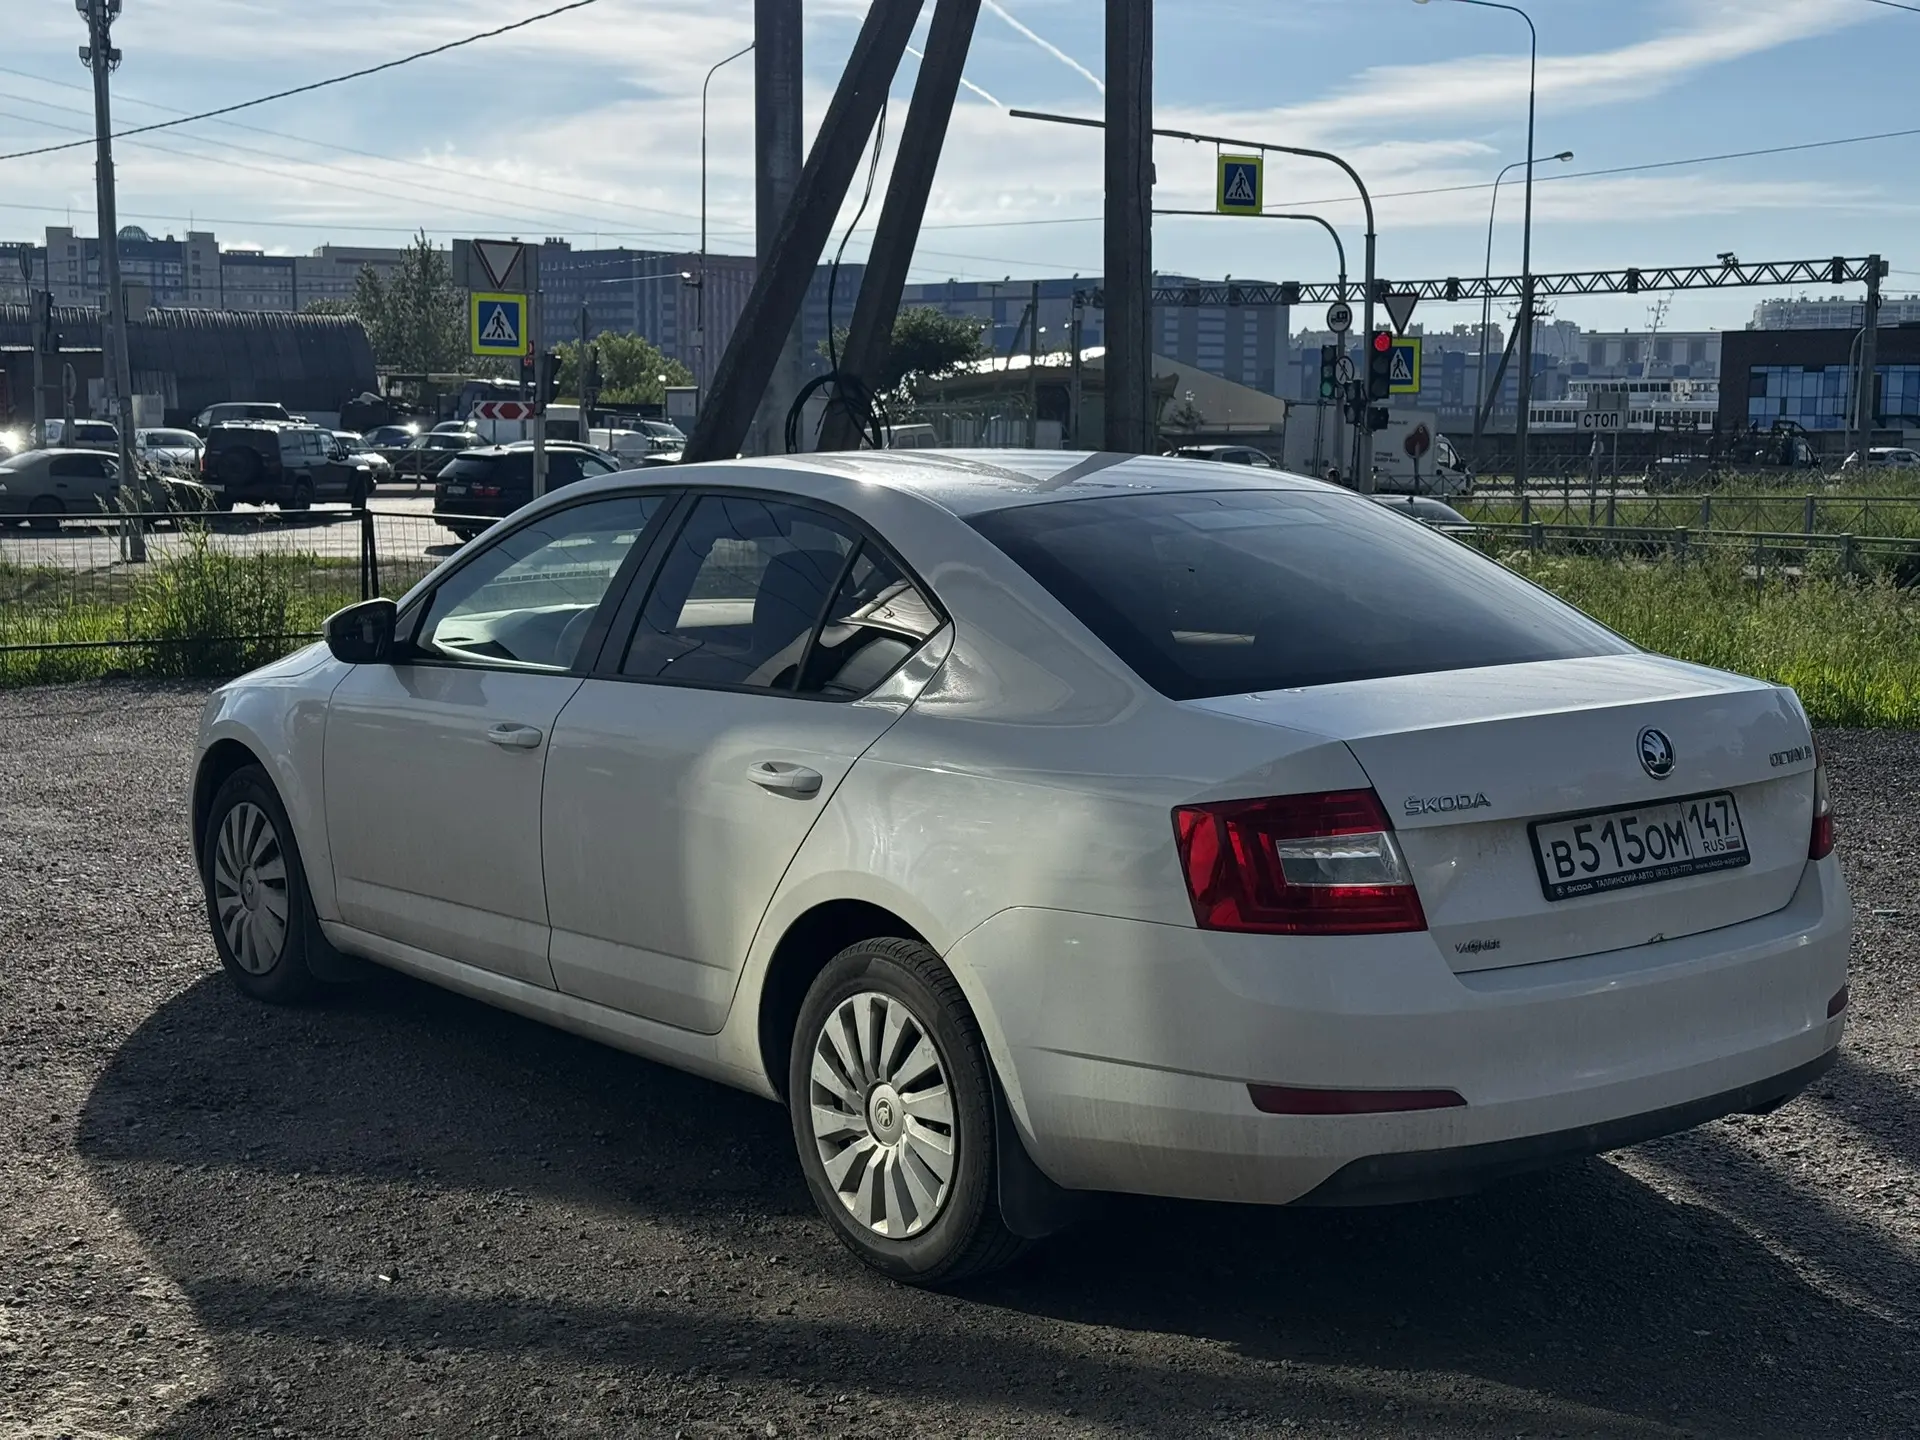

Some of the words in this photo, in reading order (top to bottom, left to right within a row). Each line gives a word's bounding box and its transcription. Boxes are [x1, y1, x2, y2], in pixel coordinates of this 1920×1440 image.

[1584, 413, 1618, 428] СТОП
[1403, 791, 1492, 816] ŠKODA
[1688, 800, 1729, 840] 147
[1703, 838, 1726, 853] RUS
